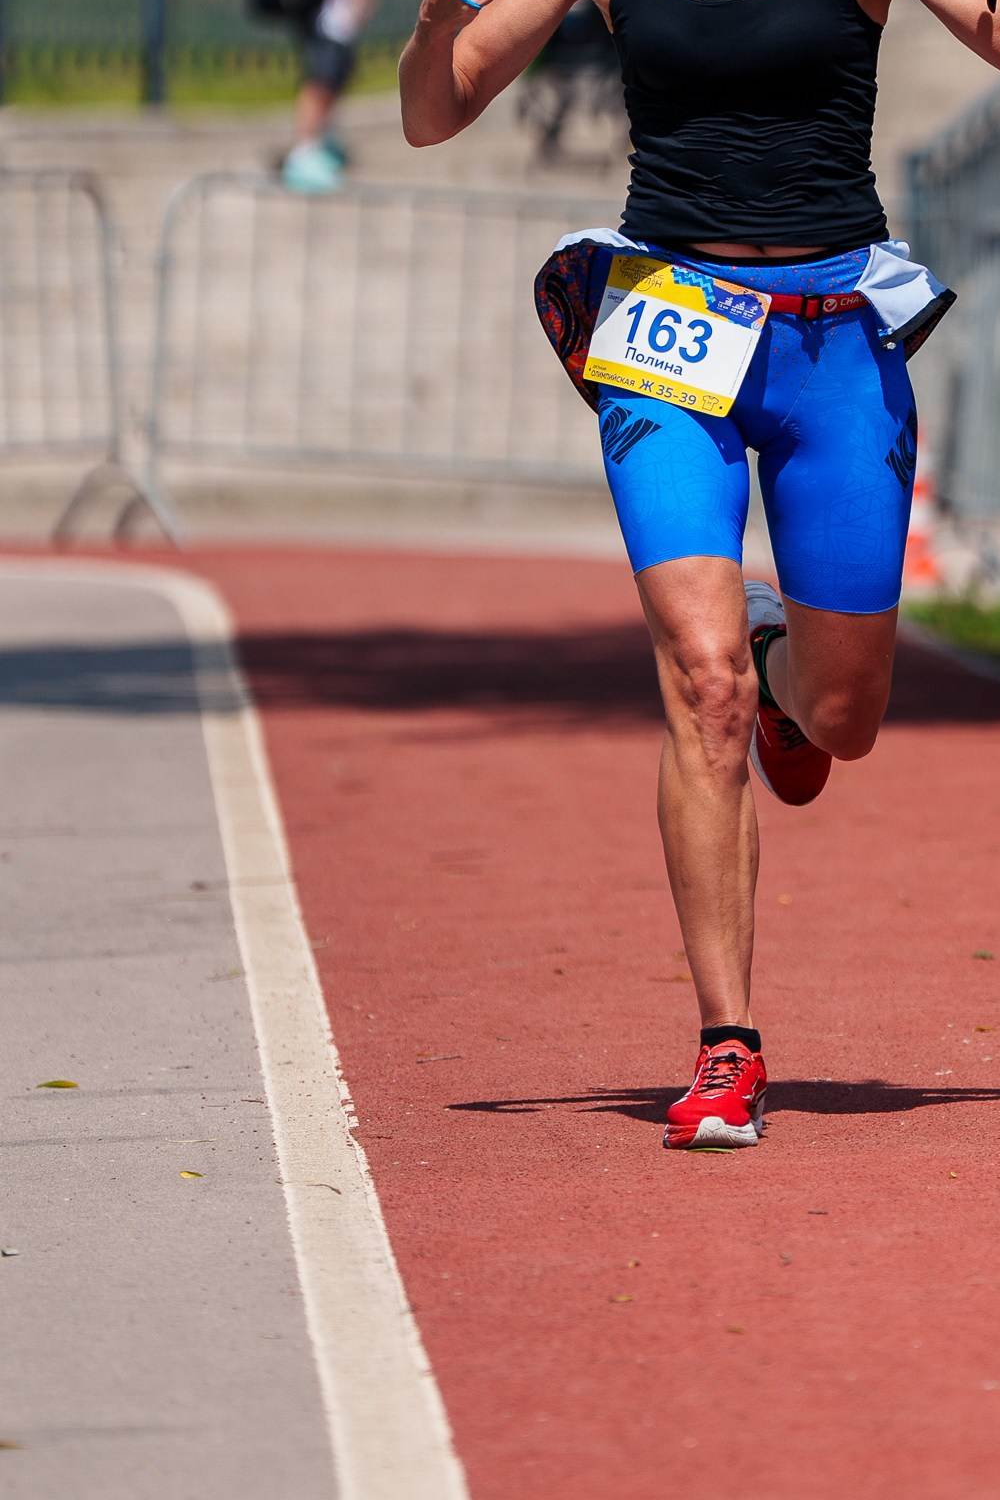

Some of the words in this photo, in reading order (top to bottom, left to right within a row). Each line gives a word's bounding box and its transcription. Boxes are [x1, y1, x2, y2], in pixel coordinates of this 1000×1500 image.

[626, 299, 714, 364] 163
[624, 346, 684, 376] Полина
[638, 378, 655, 393] Ж
[655, 384, 697, 406] 35-39
